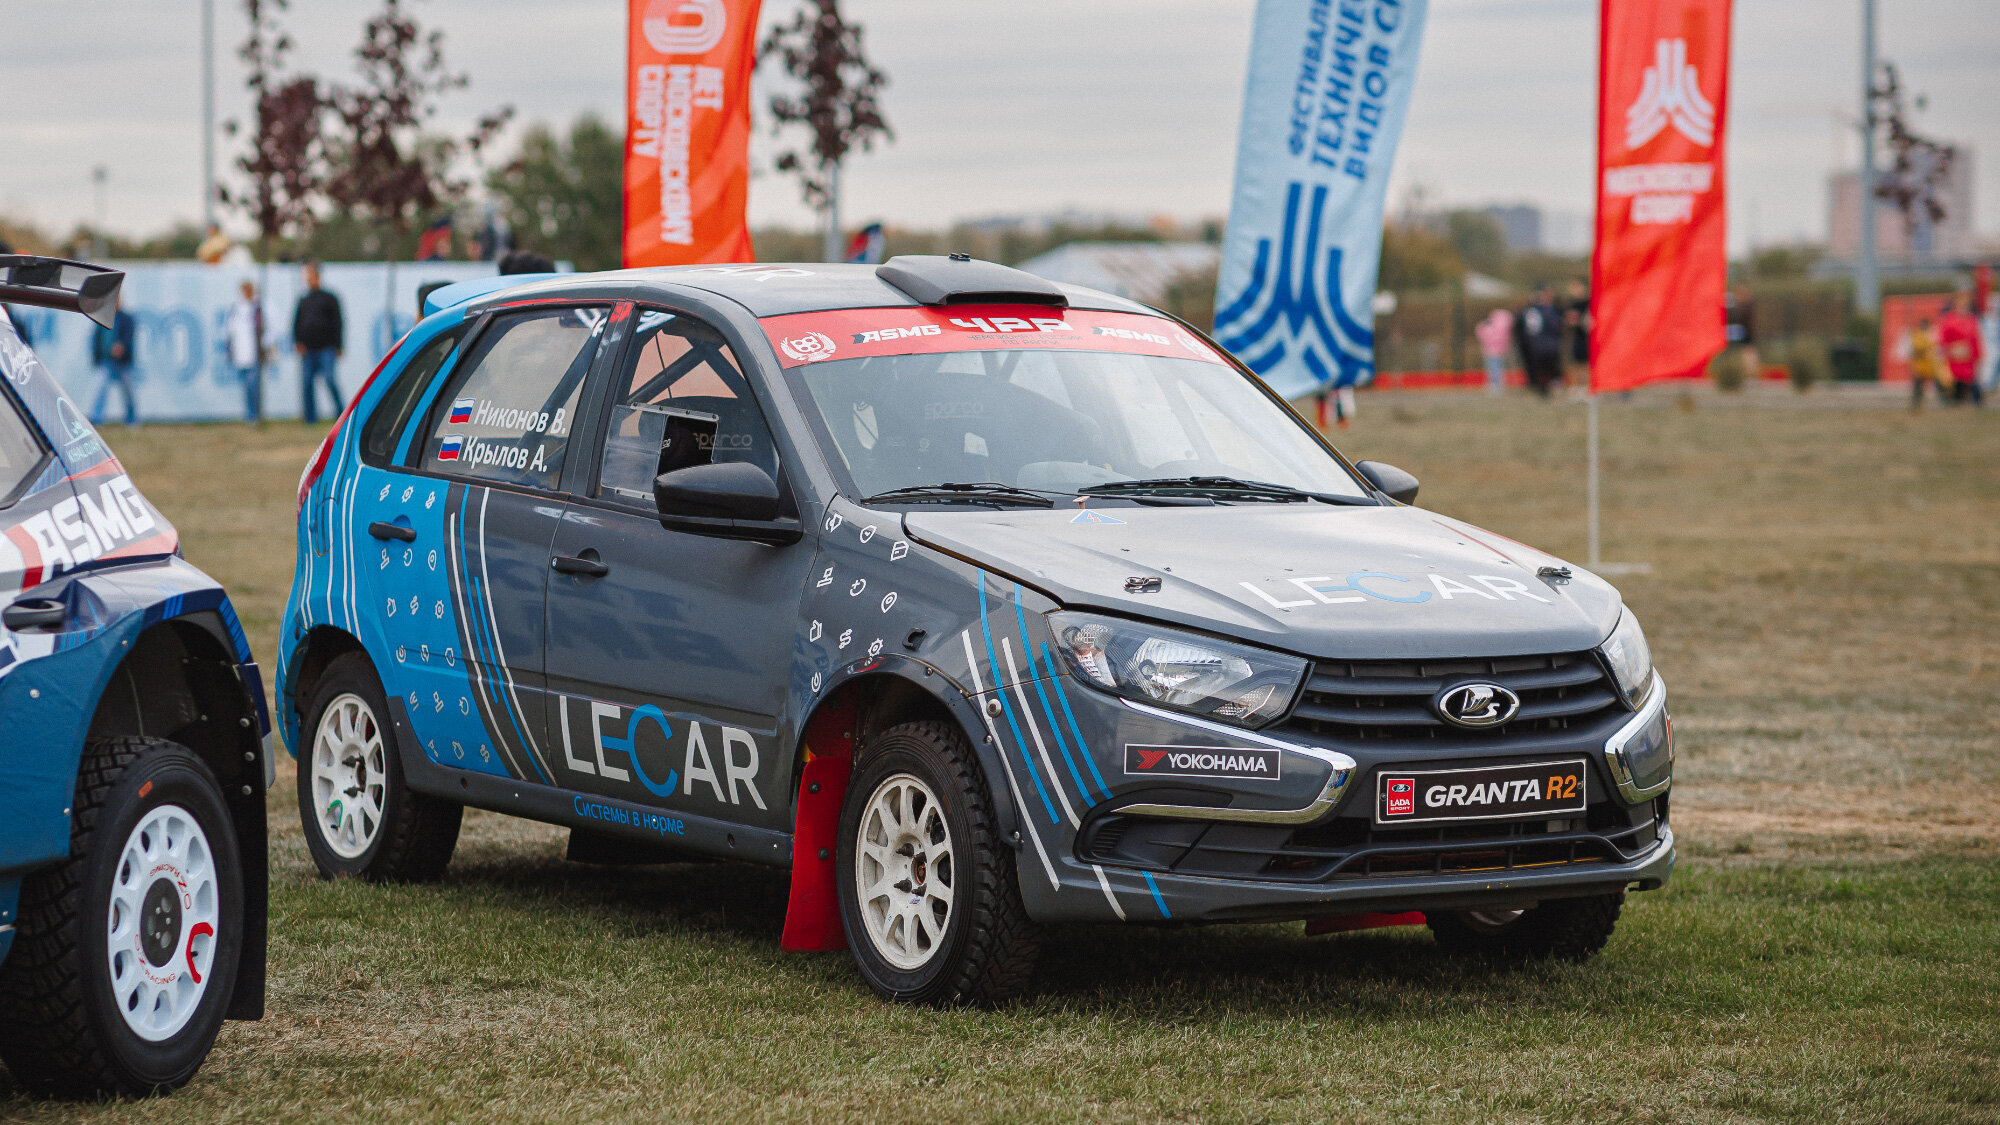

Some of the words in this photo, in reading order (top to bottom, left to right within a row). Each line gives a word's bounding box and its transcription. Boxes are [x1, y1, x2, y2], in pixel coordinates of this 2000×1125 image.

[1288, 0, 1331, 156] ФЕСТИВАЛ
[1309, 0, 1366, 169] ТЕХНИЧЕ
[1344, 43, 1390, 180] ВИДОВ
[1373, 0, 1401, 34] С
[860, 324, 942, 343] ASMG
[1097, 326, 1171, 346] ASMG
[474, 399, 549, 433] Никонов
[550, 407, 567, 435] В.
[462, 435, 529, 470] Крылов
[529, 444, 549, 473] А.
[20, 474, 155, 584] ASMG
[1238, 571, 1552, 610] LECAR
[559, 695, 768, 811] LECAR
[1167, 752, 1268, 773] YOKOHAMA
[1390, 799, 1411, 807] LADA
[1425, 778, 1541, 808] GRANTA
[1546, 774, 1578, 800] R2
[573, 795, 630, 825] Системы
[632, 811, 641, 827] в
[643, 812, 685, 837] норме
